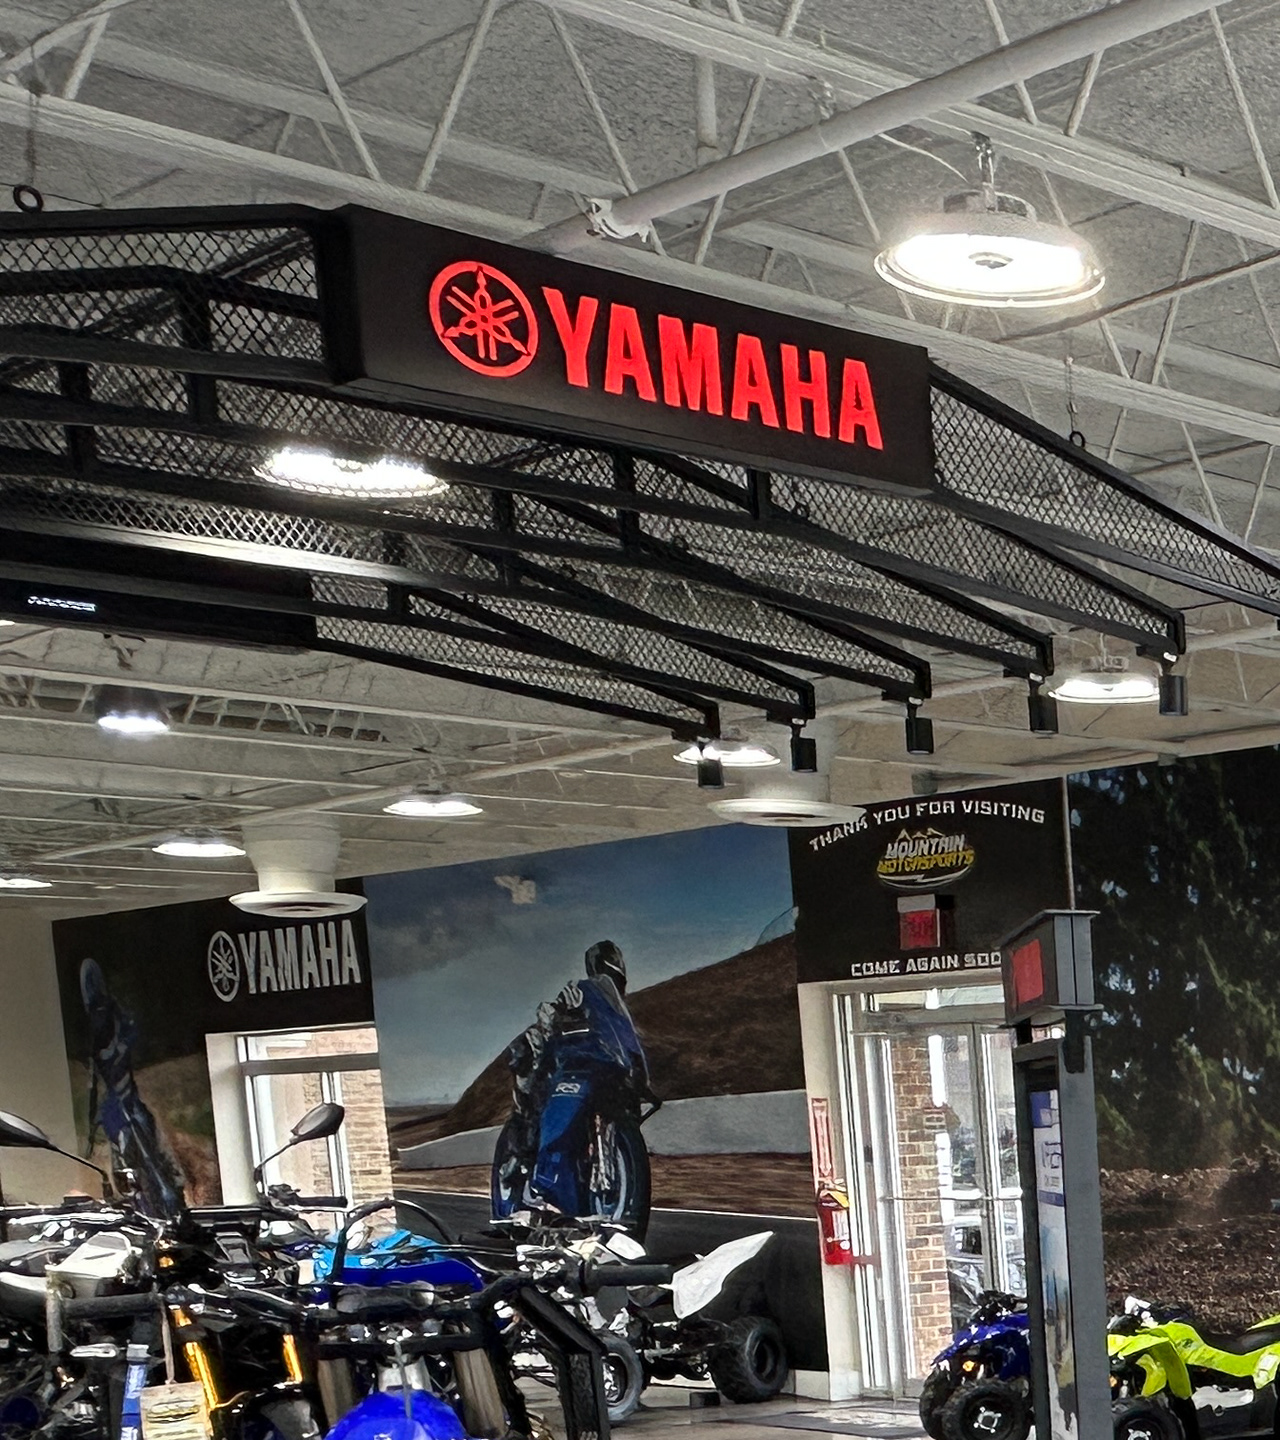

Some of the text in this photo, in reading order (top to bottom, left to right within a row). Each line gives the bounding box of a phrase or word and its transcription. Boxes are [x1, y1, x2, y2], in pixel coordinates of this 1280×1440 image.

[542, 287, 884, 451] YAMAHA
[809, 800, 1046, 851] THANK YOU FOR VISITING
[885, 834, 965, 859] MOUNTAIN
[238, 919, 361, 994] YAMAHA
[851, 951, 1002, 976] COME AGAIN SOO
